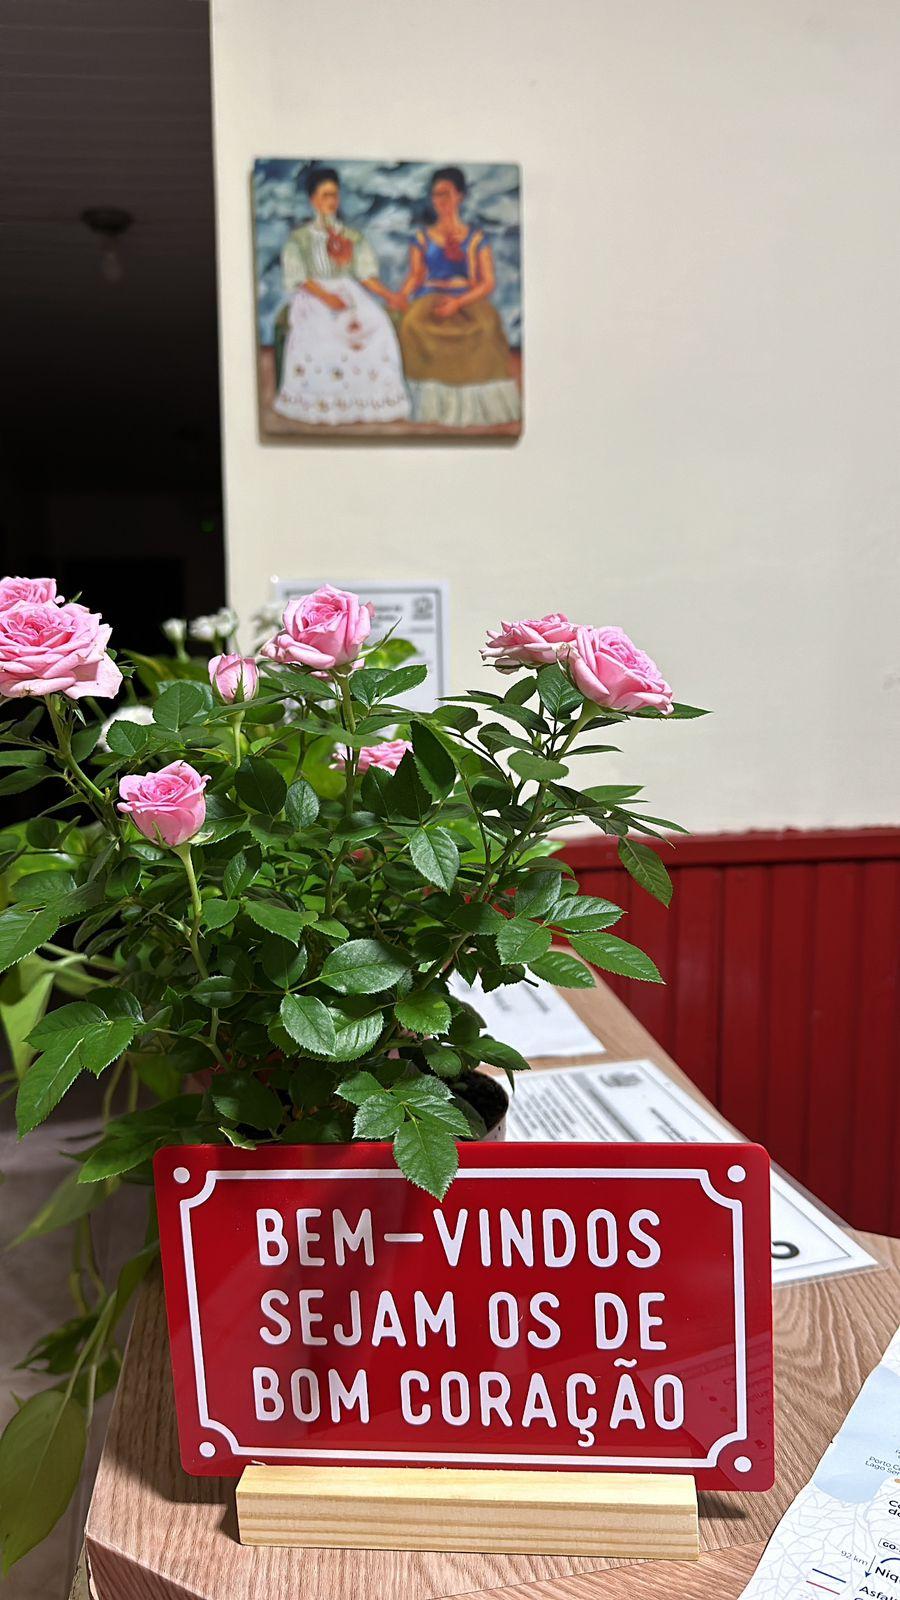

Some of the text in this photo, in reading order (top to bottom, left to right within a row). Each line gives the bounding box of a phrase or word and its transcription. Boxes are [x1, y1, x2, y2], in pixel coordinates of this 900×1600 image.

[255, 1208, 661, 1269] BEM-VINDOS
[259, 1289, 667, 1351] SEJAM OS DE
[252, 1366, 370, 1424] BOM
[400, 1357, 685, 1448] CORAÇÃO
[865, 1460, 886, 1471] Lago
[869, 1456, 892, 1468] Porto
[882, 1541, 900, 1553] GO-
[841, 1550, 869, 1567] 92 km
[874, 1566, 900, 1584] Niq
